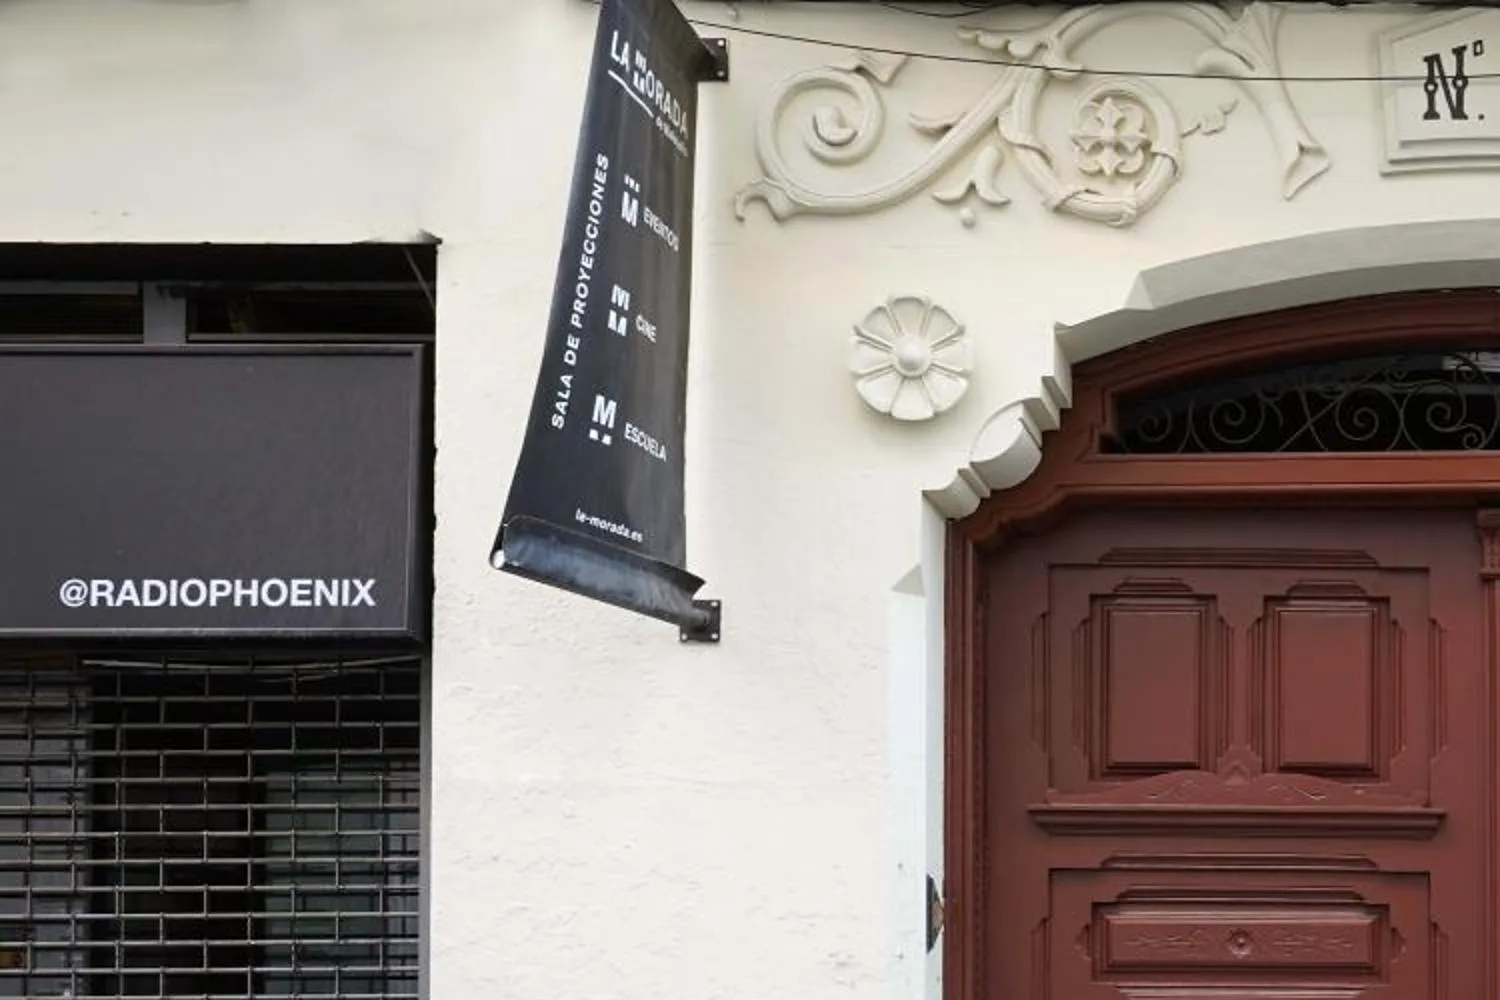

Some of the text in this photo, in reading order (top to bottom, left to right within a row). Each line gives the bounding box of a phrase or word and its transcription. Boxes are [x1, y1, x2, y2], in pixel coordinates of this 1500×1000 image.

[611, 30, 629, 72] LA
[552, 153, 609, 429] SALA DE PROYECCIONES
[624, 422, 667, 463] ESCUELA
[59, 578, 376, 607] @RADIOPHOENIX
